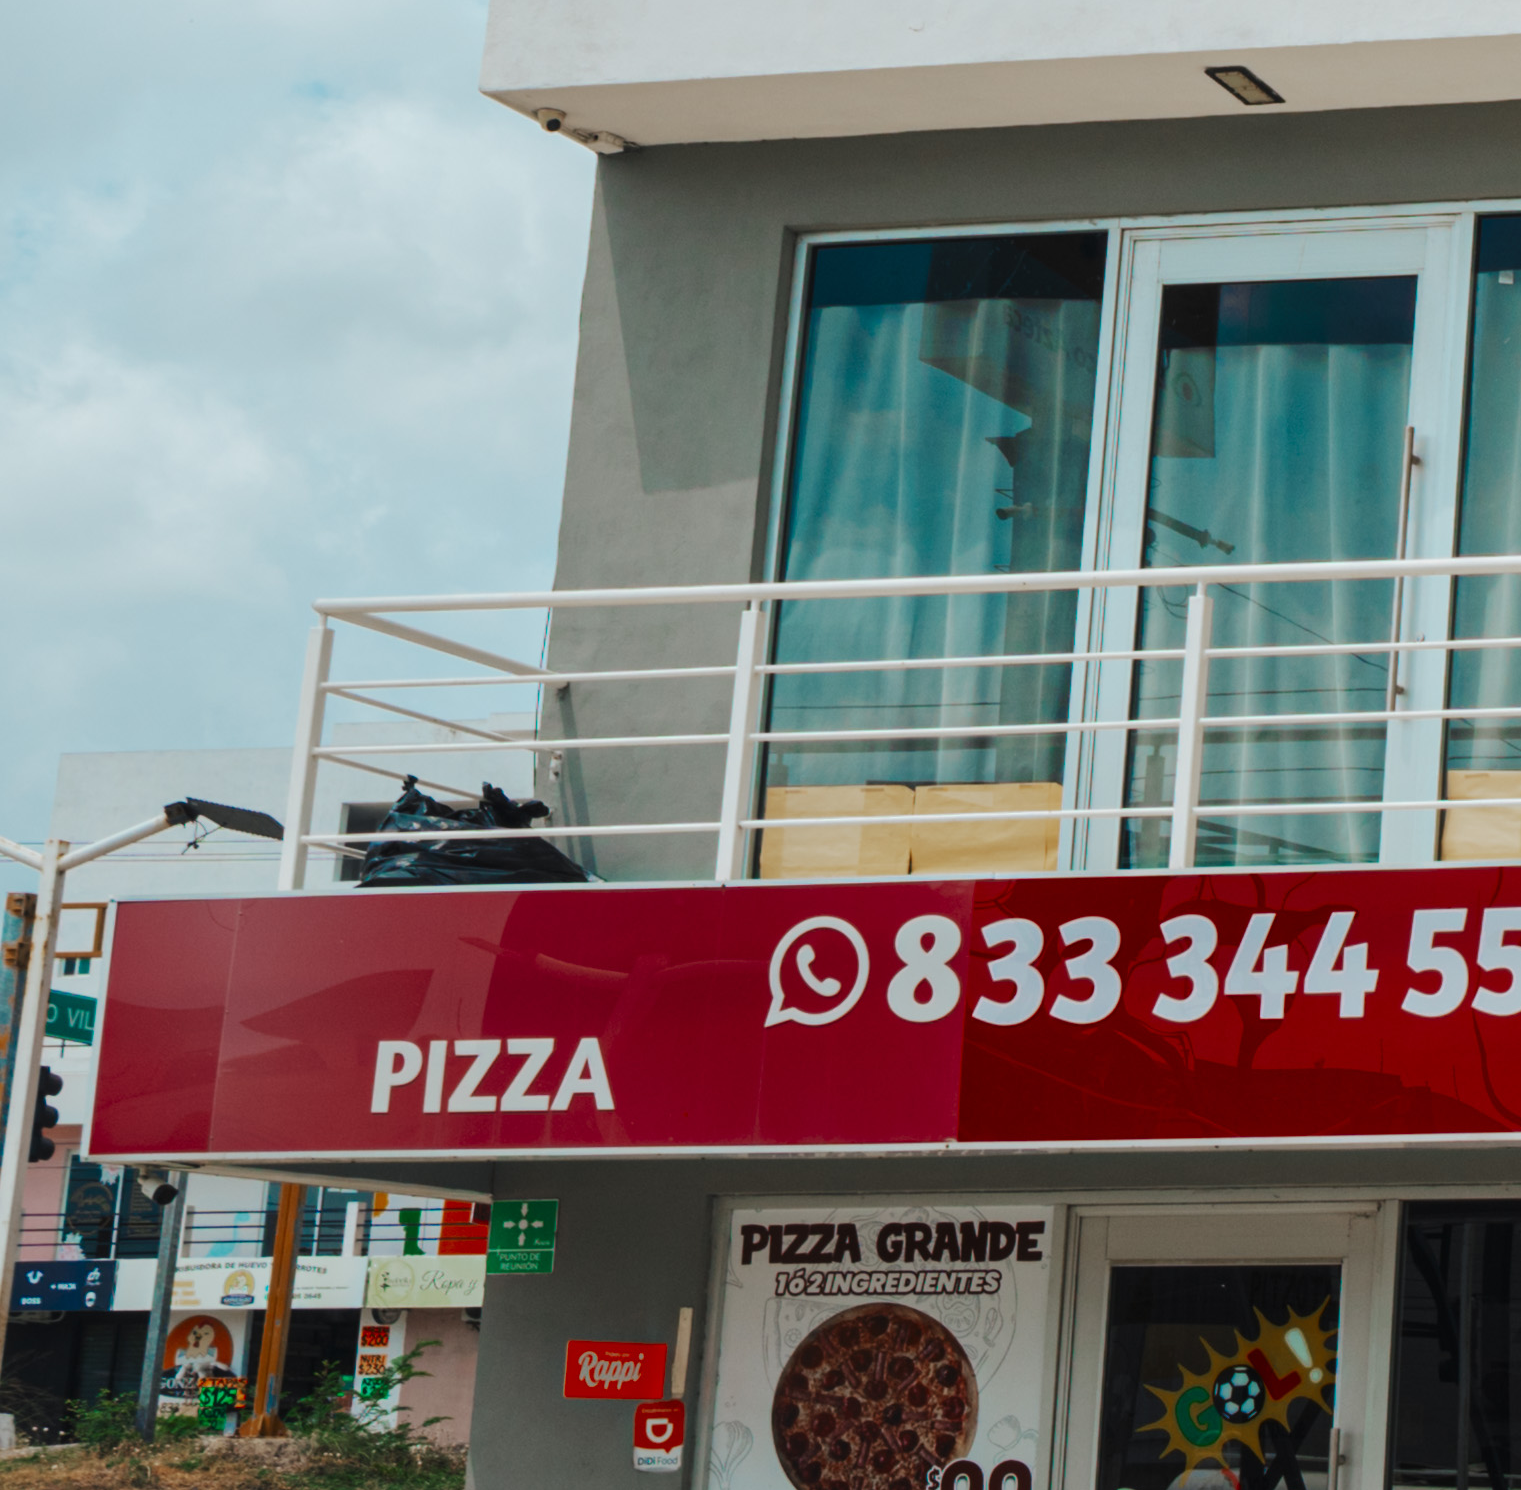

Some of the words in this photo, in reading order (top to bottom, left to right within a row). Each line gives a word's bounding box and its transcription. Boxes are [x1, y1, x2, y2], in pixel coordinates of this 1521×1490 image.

[886, 913, 1122, 1026] 833
[1151, 909, 1379, 1024] 344
[370, 1037, 616, 1114] PIZZA
[499, 1252, 527, 1261] PUNTO
[529, 1252, 541, 1261] DE
[740, 1223, 862, 1265] PIZZA
[876, 1220, 1046, 1264] GRANDE
[823, 1269, 1002, 1296] INGREDIENTES
[577, 1350, 645, 1390] Rappi
